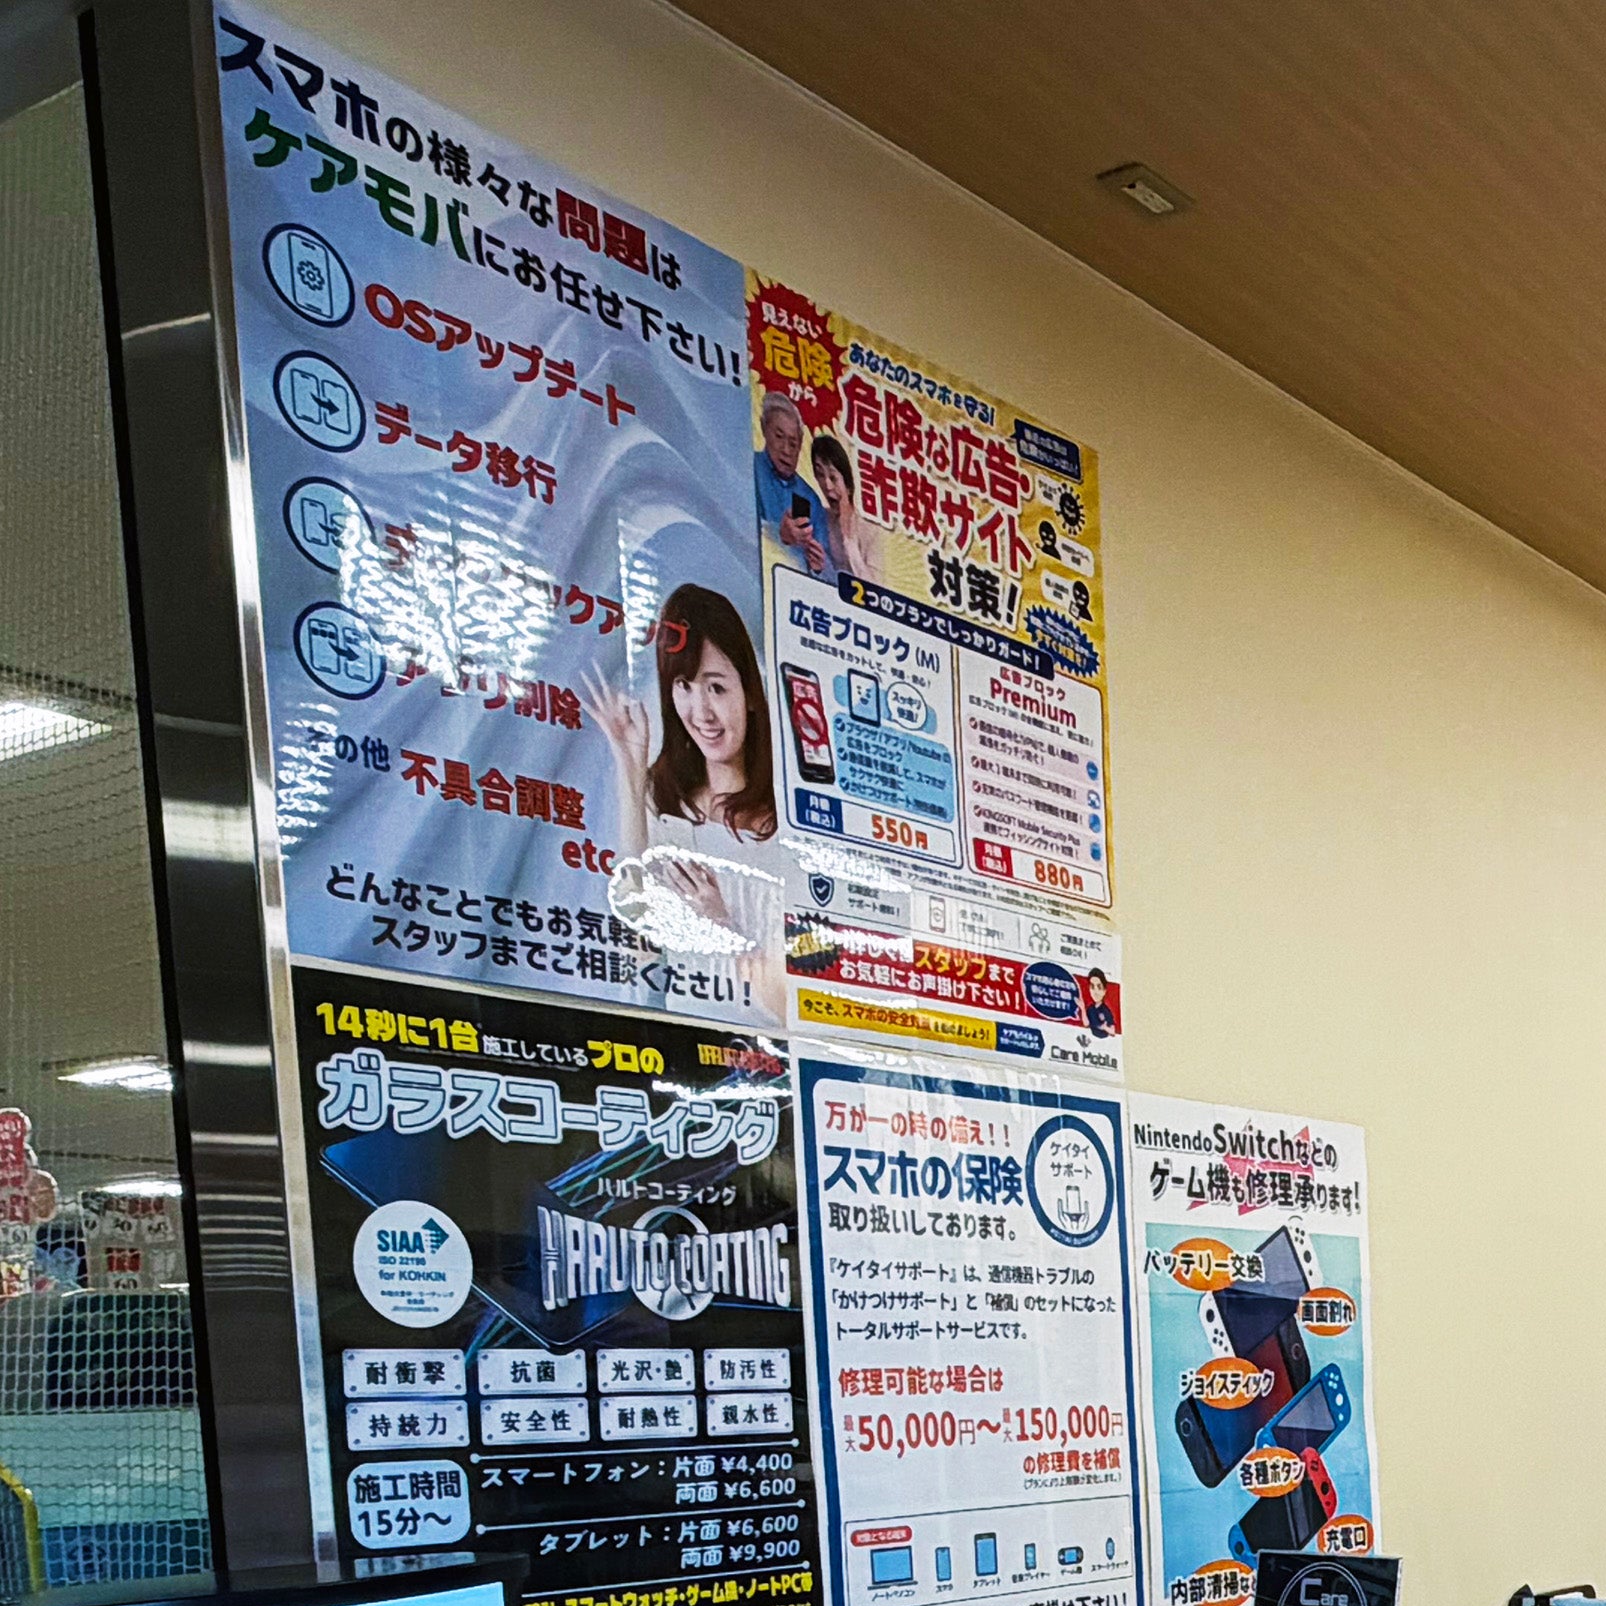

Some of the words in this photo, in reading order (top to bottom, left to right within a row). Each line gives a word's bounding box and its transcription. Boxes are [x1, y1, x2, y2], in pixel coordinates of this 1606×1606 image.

[219, 17, 682, 291] スマホの様々な問題は
[244, 108, 742, 387] ケアモバにお任せ下さい!
[762, 301, 822, 339] 見えない
[364, 284, 636, 426] OSアップデート
[762, 326, 835, 391] 危険
[787, 381, 817, 407] から
[850, 342, 995, 426] あなたのスマホを守る!
[374, 401, 557, 504] データ移行
[858, 453, 1033, 572] 詐欺サイト
[928, 549, 1021, 624] 対策!
[789, 600, 911, 663] 広告ブロック
[990, 677, 1077, 729] Premium
[400, 749, 586, 830] 不具合調整
[872, 814, 928, 850] 550円
[1034, 859, 1083, 891] 880円
[371, 915, 752, 1006] スタッフまでご相談ください!
[839, 959, 1020, 1010] お気軽にお声掛け下さい!
[1051, 1045, 1079, 1062] Care
[1083, 1052, 1118, 1069] Mobile
[316, 1048, 779, 1166] ガラスコーティング
[824, 1100, 1011, 1148] 万が一の時の備え!!
[1050, 1142, 1090, 1160] ケイタイ
[823, 1145, 1024, 1207] スマホの保険
[1050, 1161, 1093, 1180] サポート
[1151, 1157, 1361, 1215] ゲーム機も修理承ります!
[597, 1177, 737, 1208] ハルトコーティング
[828, 1202, 1017, 1242] 取り扱いしております。
[377, 1229, 426, 1254] SIAA
[378, 1268, 395, 1282] for
[397, 1268, 447, 1283] KOHKIN
[1144, 1251, 1264, 1279] バッテリー交換
[1301, 1300, 1354, 1323] 画面割れ
[836, 1321, 1029, 1341] トータルサポートサービスです。
[365, 1362, 446, 1386] 耐衝撃
[511, 1361, 556, 1384] 抗菌
[719, 1358, 777, 1380] 防汚性
[838, 1364, 1004, 1397] 修理可能な場合は
[1181, 1369, 1274, 1397] ジョイスティック
[369, 1411, 448, 1437] 持続力
[500, 1408, 571, 1434] 安全性
[618, 1405, 682, 1429] 耐熱性
[721, 1403, 777, 1425] 親水性
[672, 1454, 715, 1479] 片面
[721, 1452, 793, 1477] ¥4,400
[1023, 1448, 1121, 1475] の修理費を補償
[1240, 1460, 1304, 1487] 各種ボタン
[354, 1471, 462, 1504] 施工時間
[675, 1481, 718, 1504] 両面
[724, 1478, 796, 1501] ¥6,600
[677, 1518, 721, 1544] 片面
[727, 1514, 799, 1539] ¥6,600
[1326, 1525, 1366, 1551] 充電口
[680, 1545, 723, 1568] 両面
[729, 1539, 801, 1563] ¥9,900
[1300, 1578, 1348, 1606] Care
